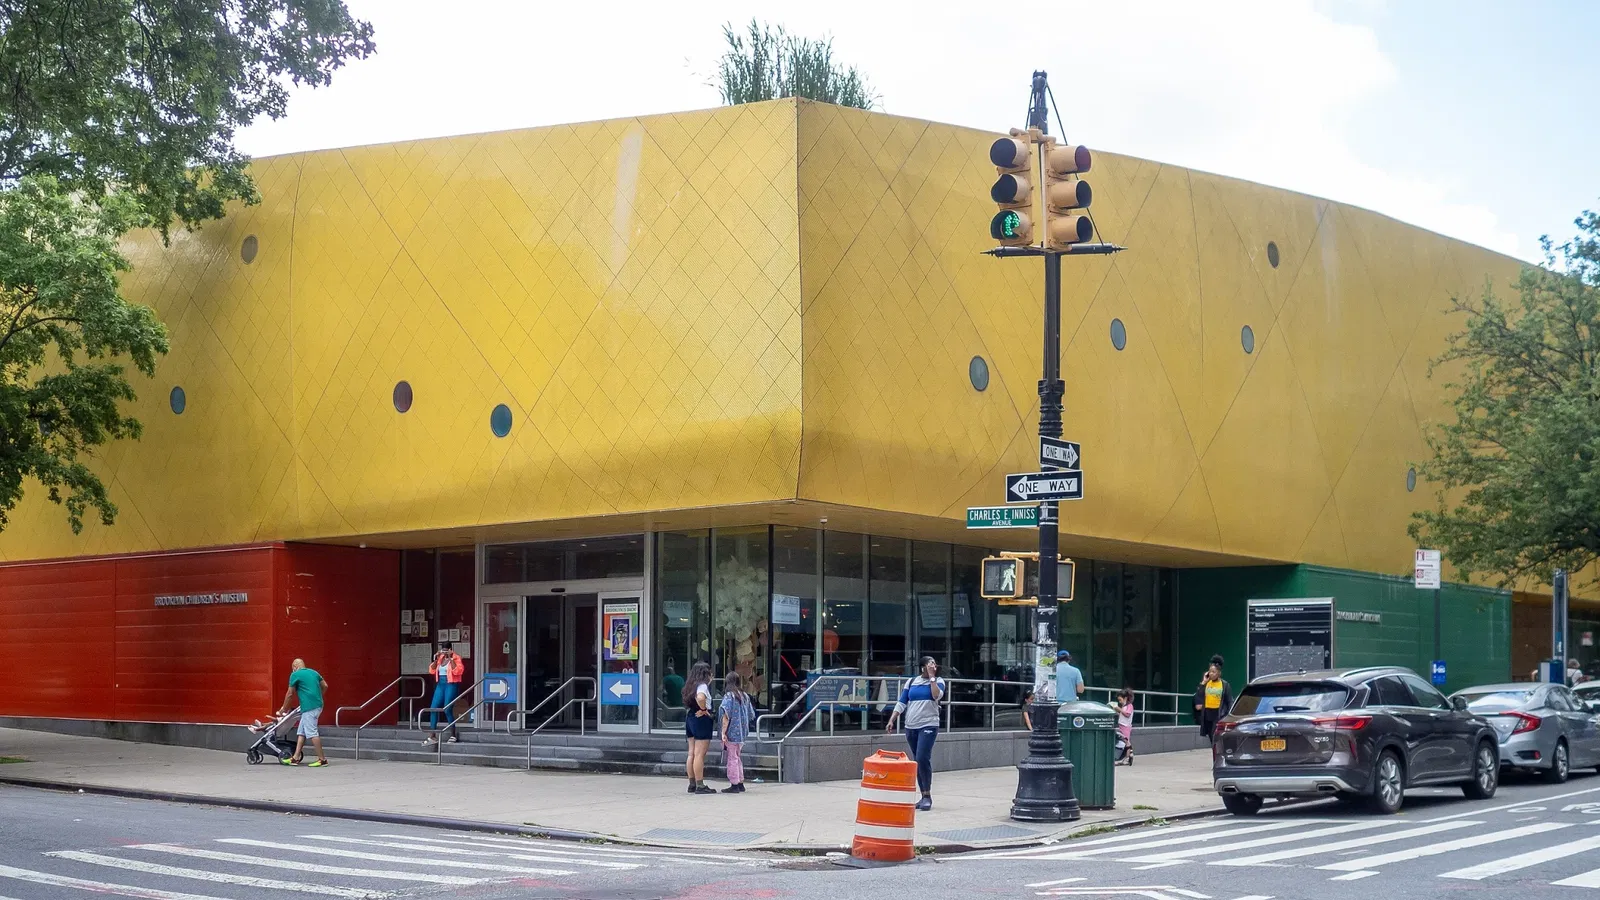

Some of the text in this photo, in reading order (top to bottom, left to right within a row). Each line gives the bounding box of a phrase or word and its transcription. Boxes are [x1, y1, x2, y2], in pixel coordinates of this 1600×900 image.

[1045, 446, 1075, 462] ONE WAY
[1018, 479, 1073, 494] ONE WAY
[969, 508, 1035, 521] CHARLES E. INNISS
[155, 592, 248, 606] BROOKLYN CHILDREN'S MUSEUM
